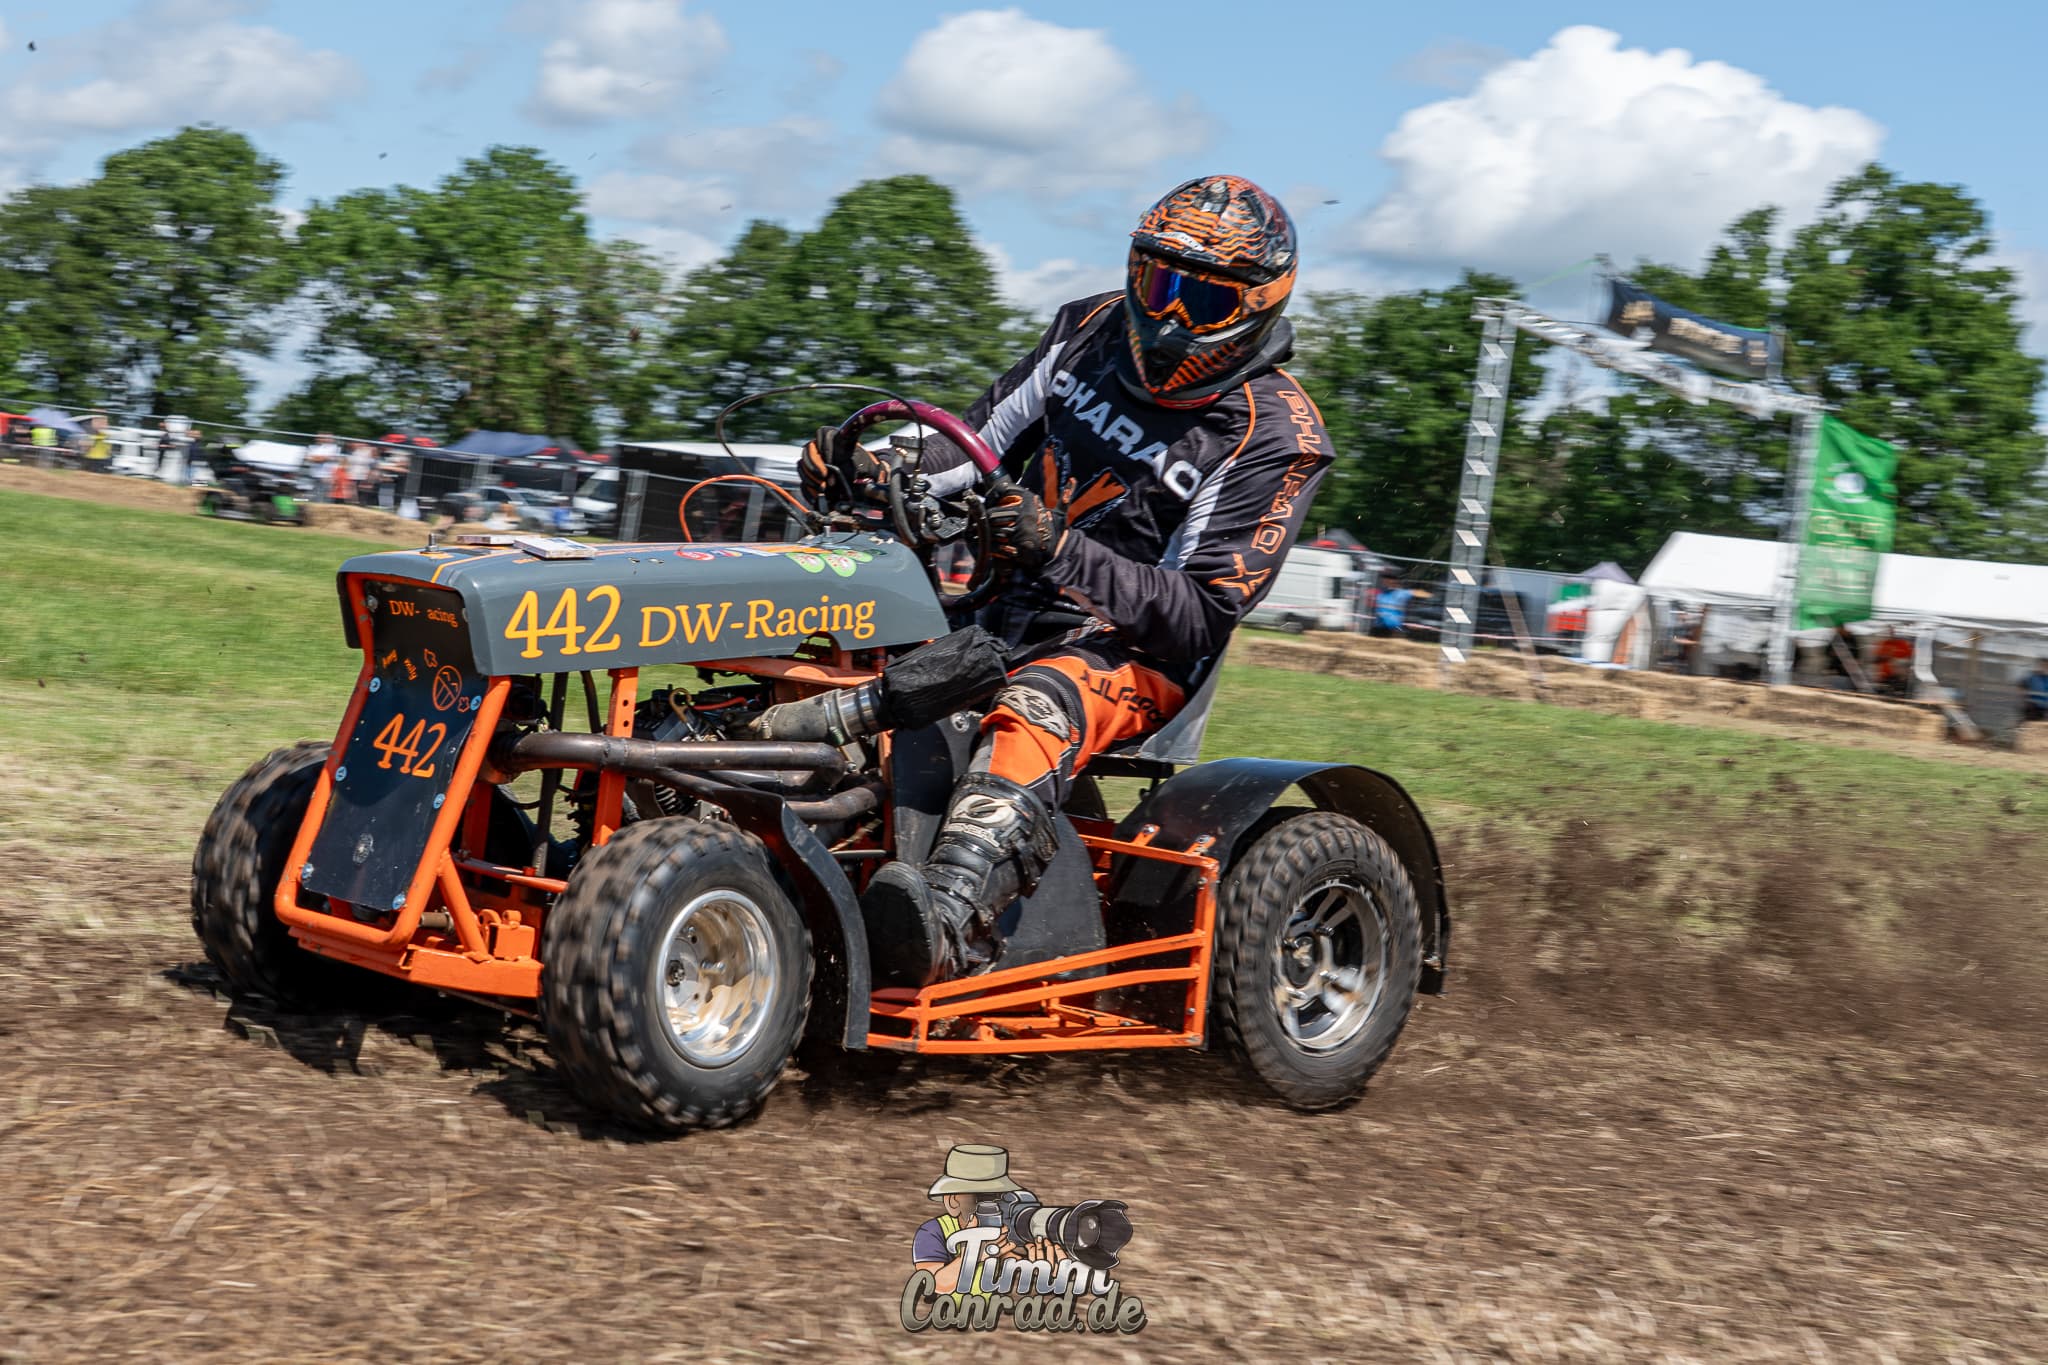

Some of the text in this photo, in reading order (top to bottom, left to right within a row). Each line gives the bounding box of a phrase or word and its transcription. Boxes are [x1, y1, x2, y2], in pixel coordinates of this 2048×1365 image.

[504, 584, 877, 660] 442 DW-Racing
[373, 713, 447, 778] 442
